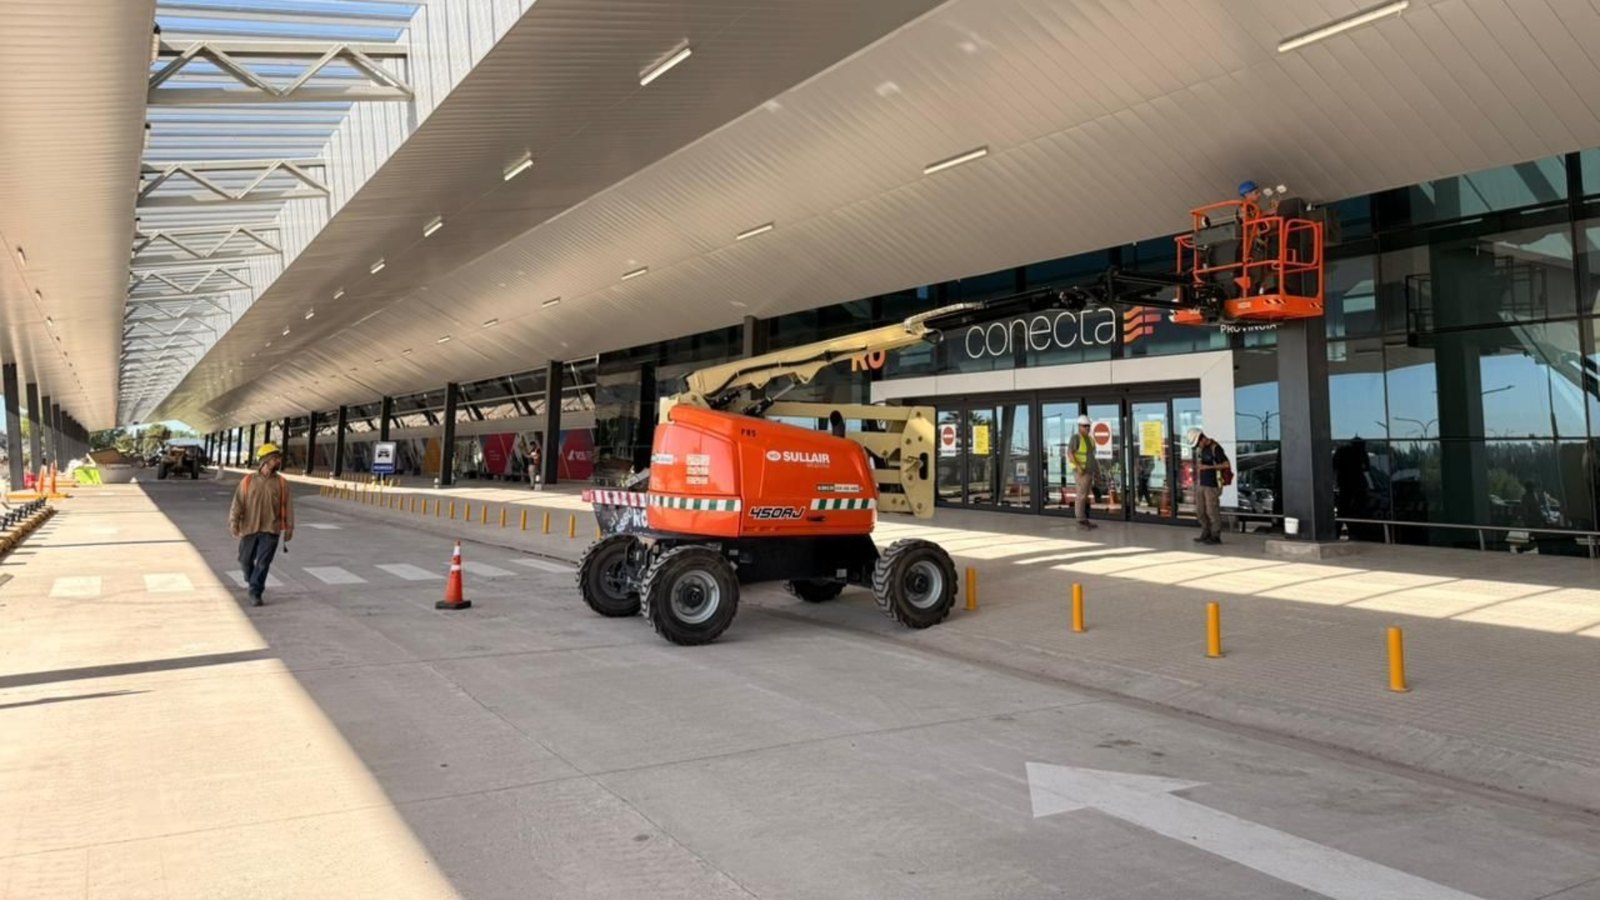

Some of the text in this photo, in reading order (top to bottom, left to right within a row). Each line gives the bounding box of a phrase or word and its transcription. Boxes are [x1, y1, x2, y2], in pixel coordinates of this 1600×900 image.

[965, 307, 1116, 358] conecta
[783, 451, 831, 464] SULLAIR
[748, 506, 806, 520] 450AJ
